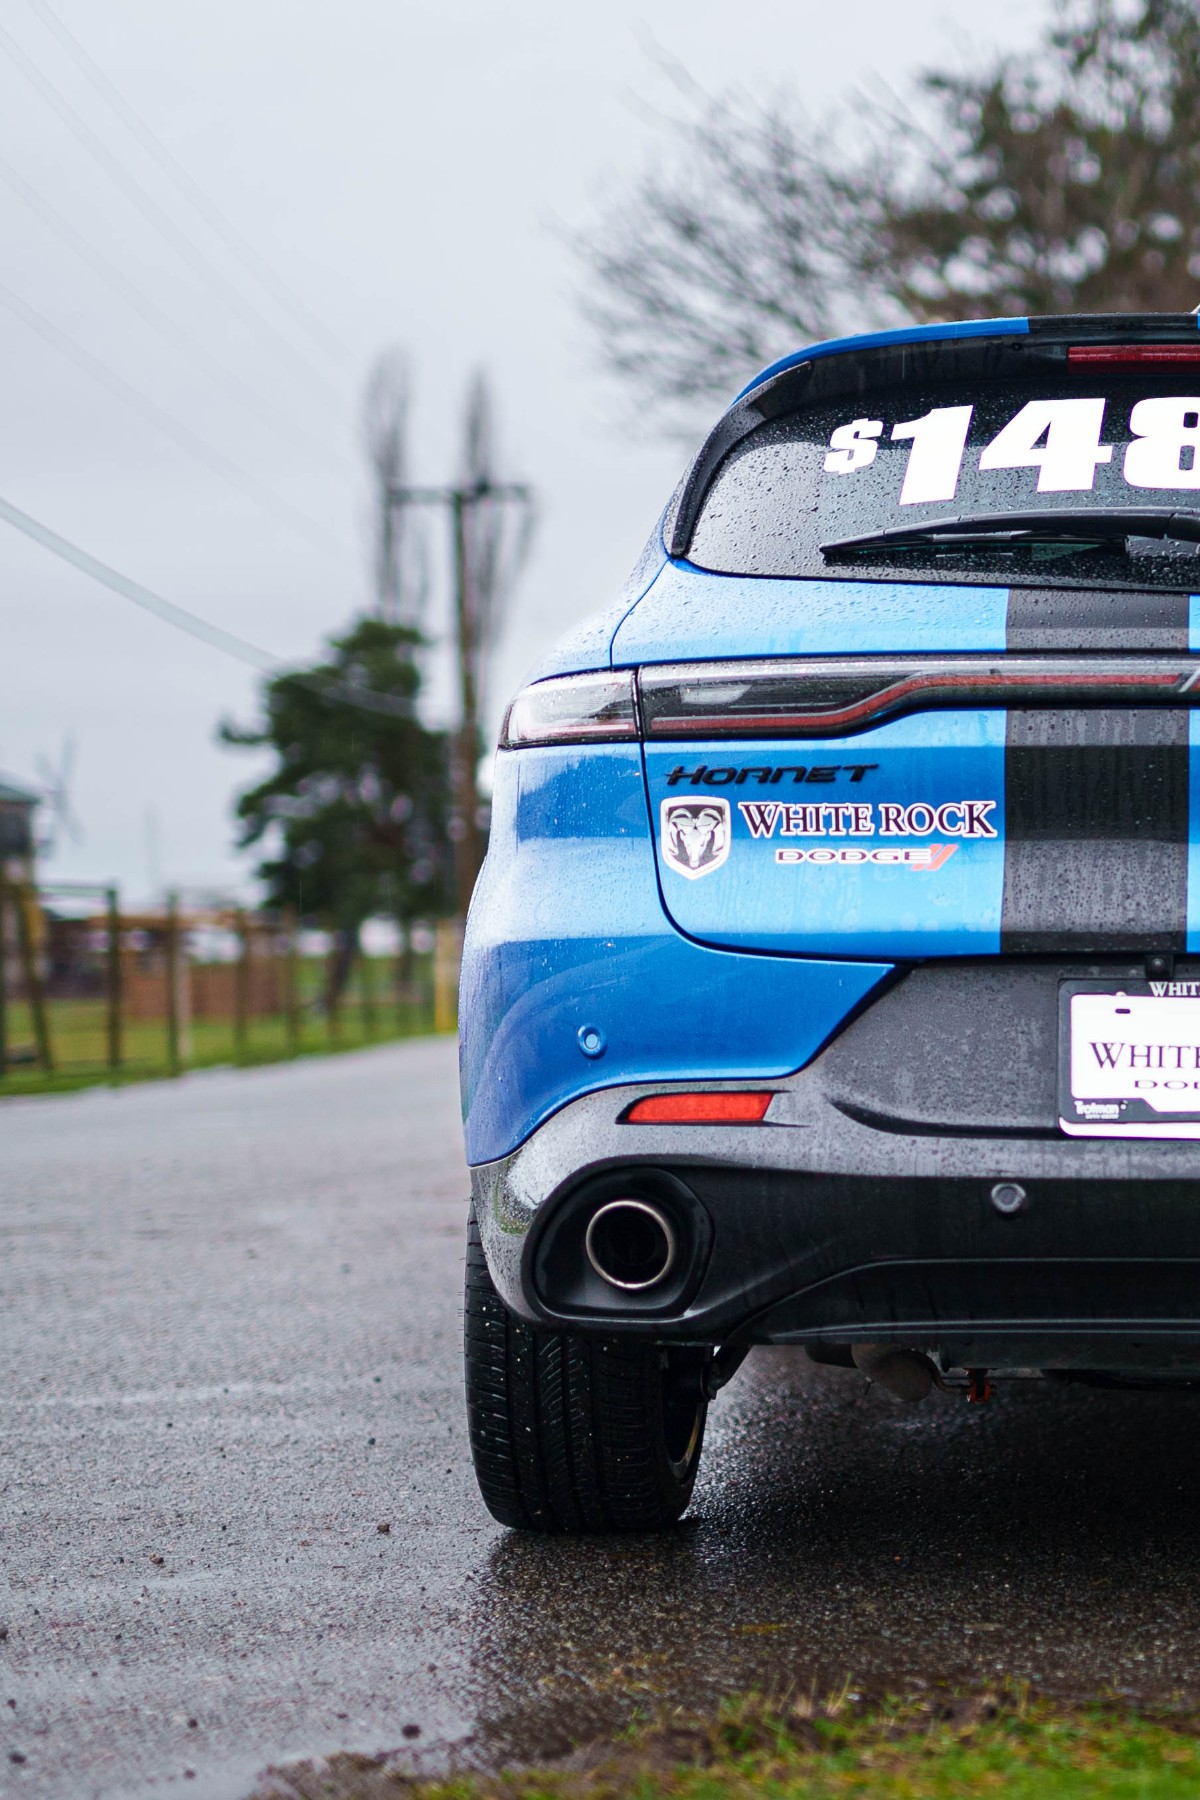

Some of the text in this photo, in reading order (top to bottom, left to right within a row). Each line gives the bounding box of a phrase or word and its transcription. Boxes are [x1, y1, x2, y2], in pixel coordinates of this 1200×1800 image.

[664, 763, 879, 786] HORNET
[740, 801, 997, 837] WHITE ROCK
[776, 849, 932, 863] DODGE
